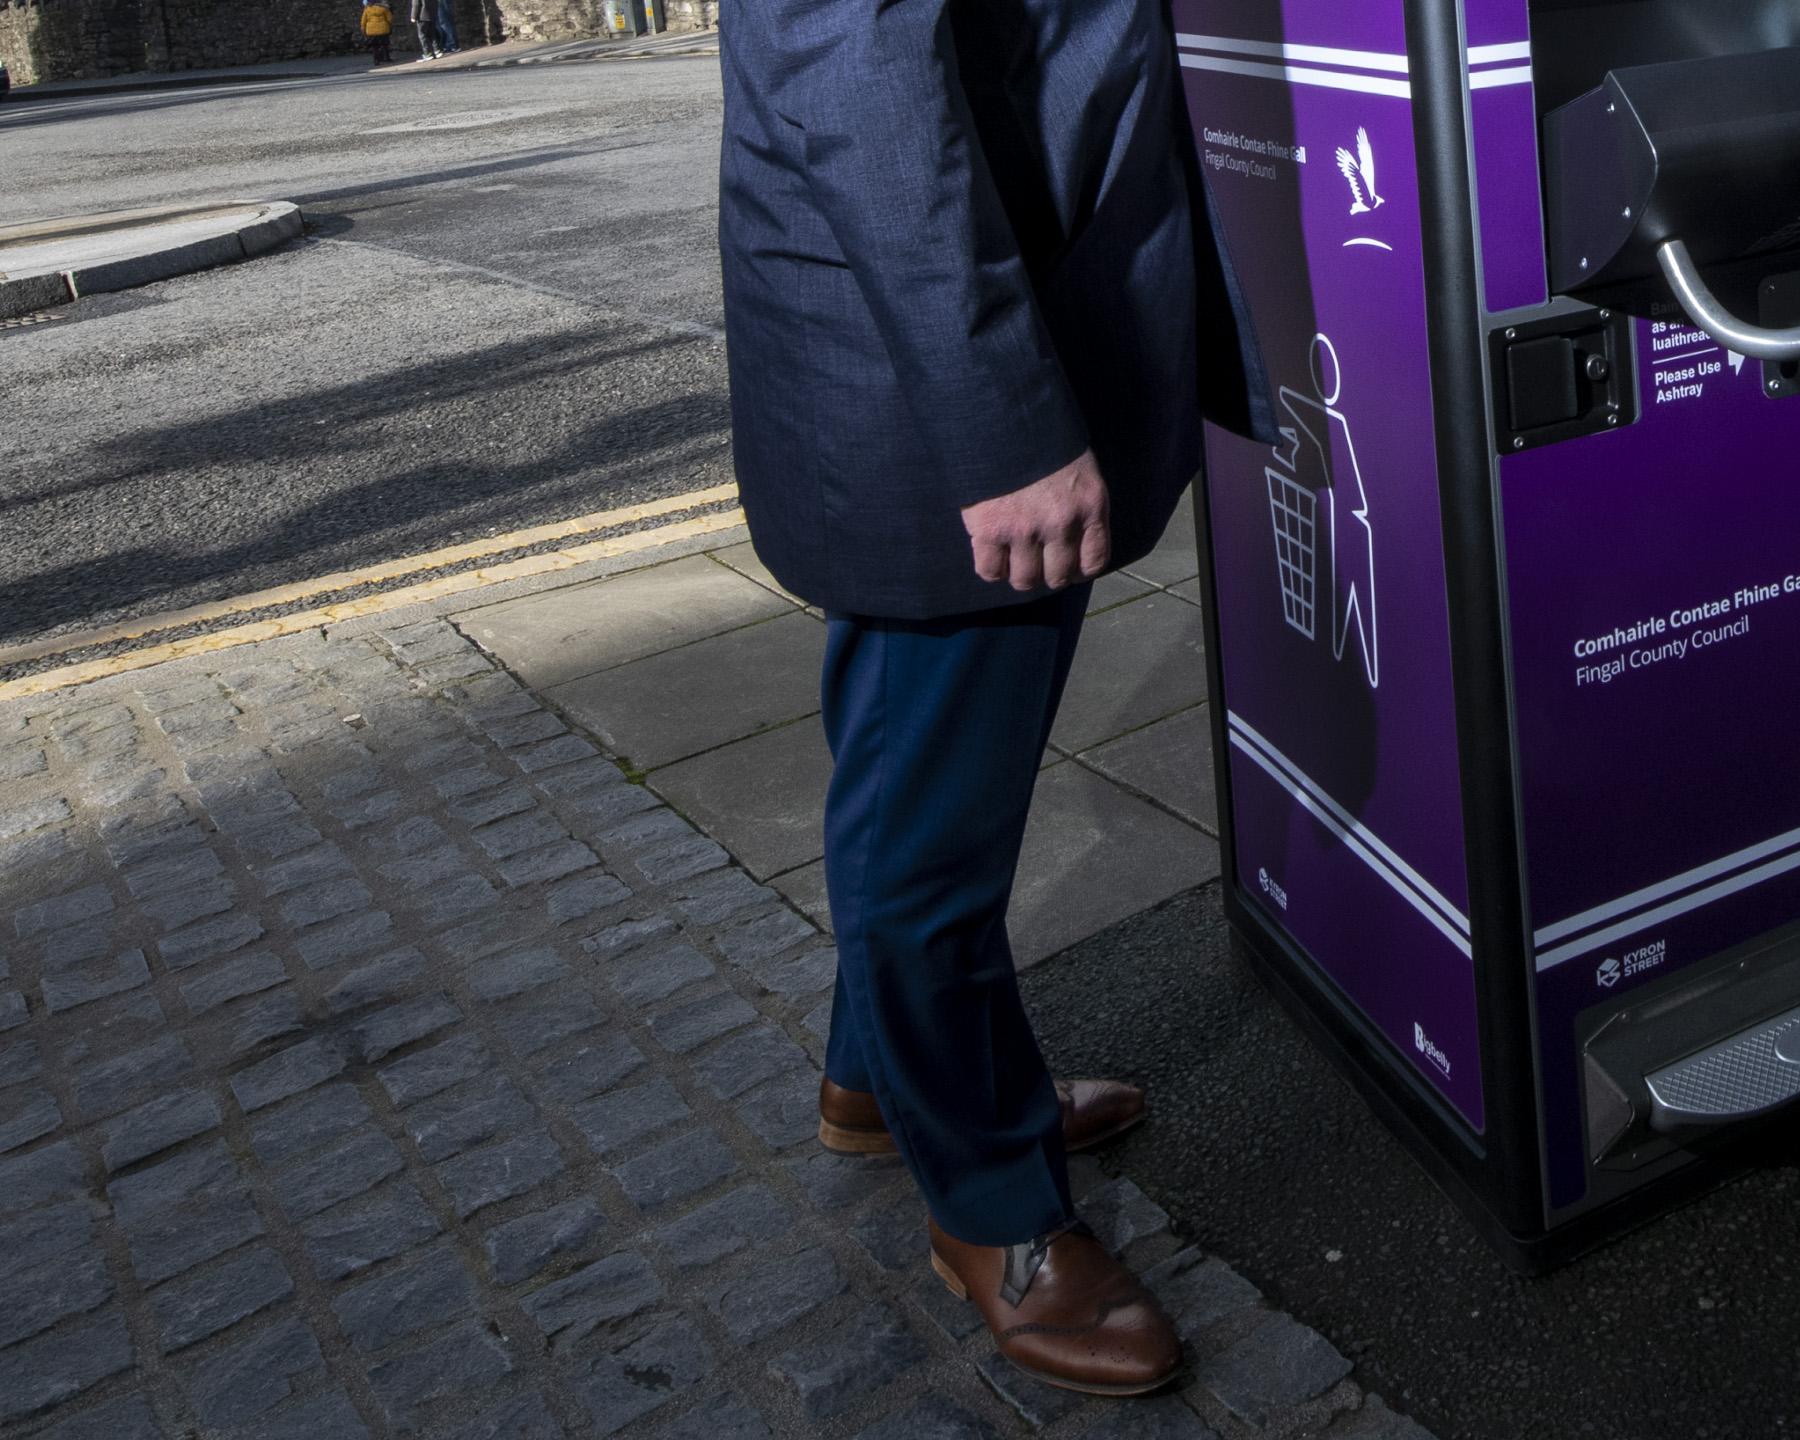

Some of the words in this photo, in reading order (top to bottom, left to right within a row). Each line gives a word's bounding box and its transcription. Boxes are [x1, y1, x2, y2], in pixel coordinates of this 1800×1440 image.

[1203, 127, 1240, 148] Comhairle
[1240, 135, 1266, 154] Contae
[1267, 140, 1289, 159] Fhine
[1290, 146, 1306, 164] Gall
[1205, 149, 1225, 170] Fingal
[1225, 154, 1249, 177] County
[1250, 160, 1277, 180] Council
[1652, 322, 1666, 334] as
[1655, 367, 1695, 386] Please
[1698, 361, 1721, 376] Use
[1656, 383, 1703, 404] Ashtray
[1574, 617, 1666, 658] Comhairle
[1670, 597, 1730, 629] Contae
[1734, 581, 1780, 609] Fhine
[1576, 655, 1625, 686] Fingal
[1629, 638, 1688, 669] County
[1691, 614, 1750, 649] Council
[1623, 939, 1666, 966] KYRON
[1623, 951, 1666, 977] STREET
[1414, 1021, 1451, 1073] Bigbelly
